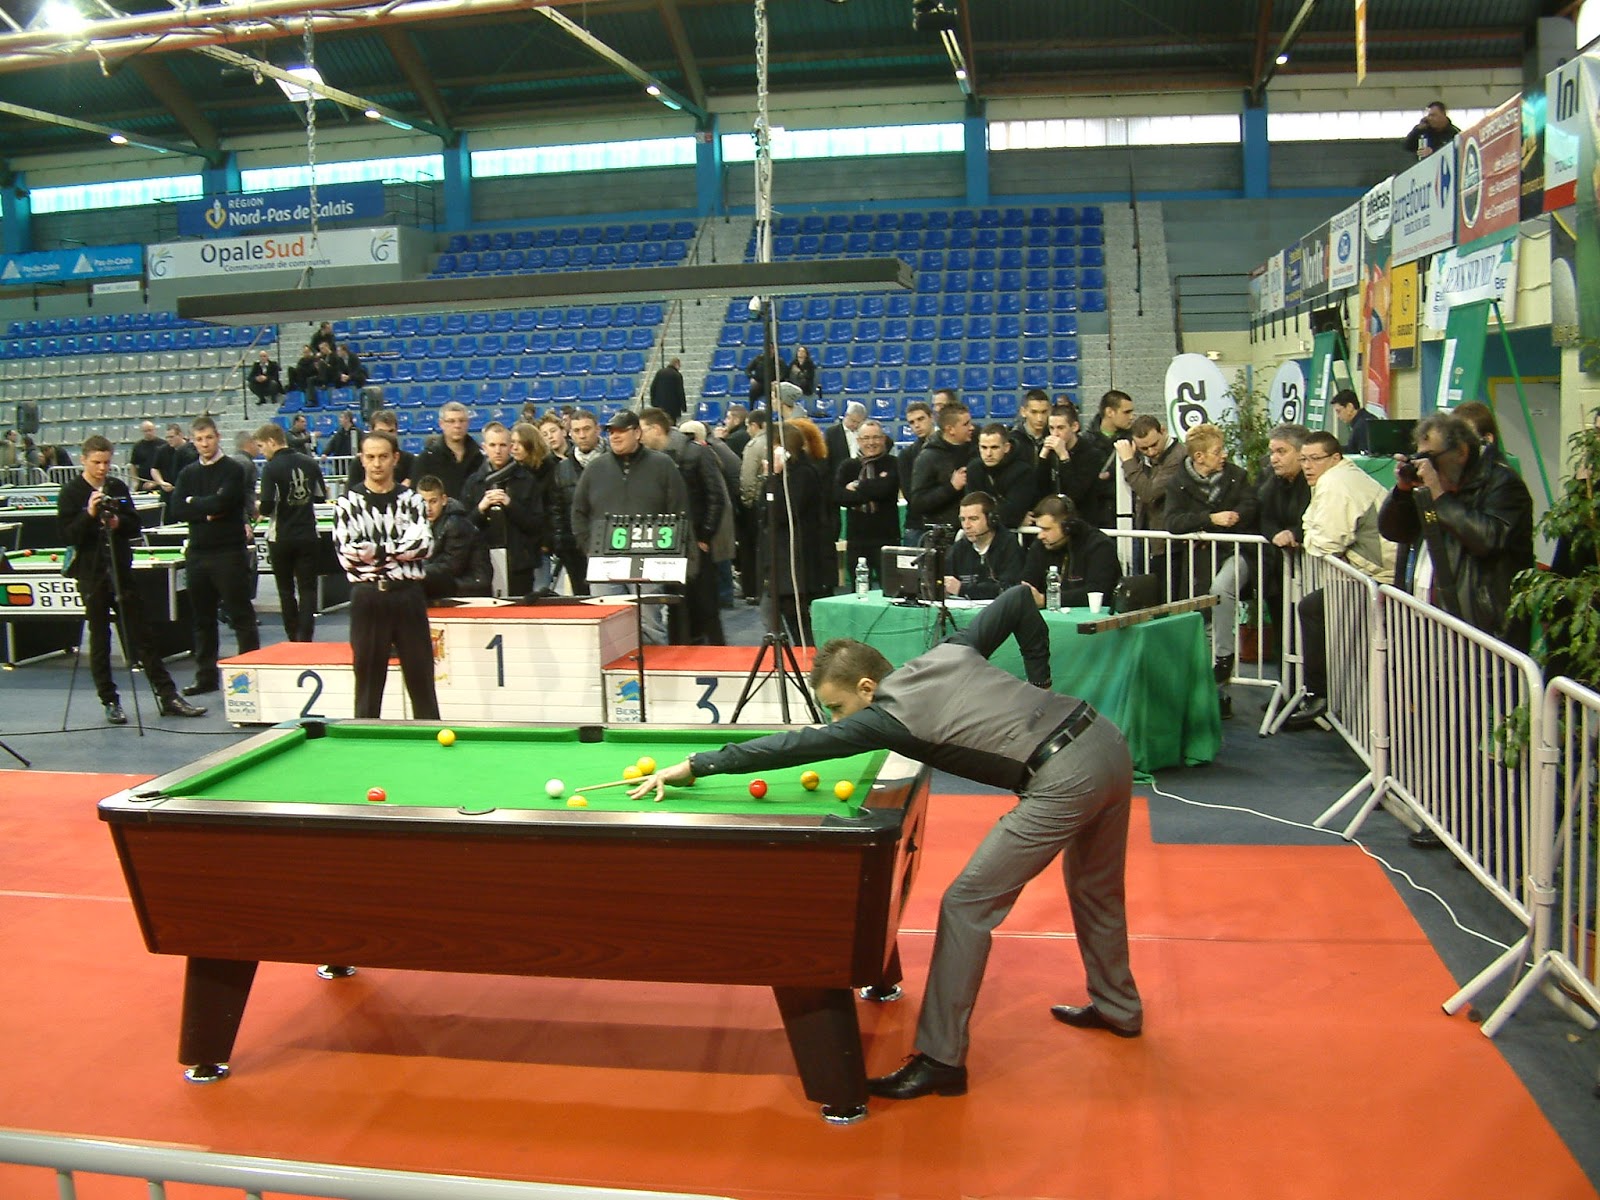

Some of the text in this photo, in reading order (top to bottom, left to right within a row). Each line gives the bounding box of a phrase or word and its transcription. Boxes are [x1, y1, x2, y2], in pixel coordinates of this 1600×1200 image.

[228, 198, 264, 208] RÉGION
[229, 200, 354, 226] Nord-Pas de Calais
[1392, 178, 1432, 224] arrefour
[201, 236, 304, 267] OpaleSud
[611, 526, 673, 549] 6 2 1 3
[38, 581, 80, 594] SEG
[41, 595, 52, 607] 8
[485, 634, 505, 687] 1
[297, 669, 326, 718] 2
[695, 677, 720, 724] 3
[615, 707, 641, 715] BERC
